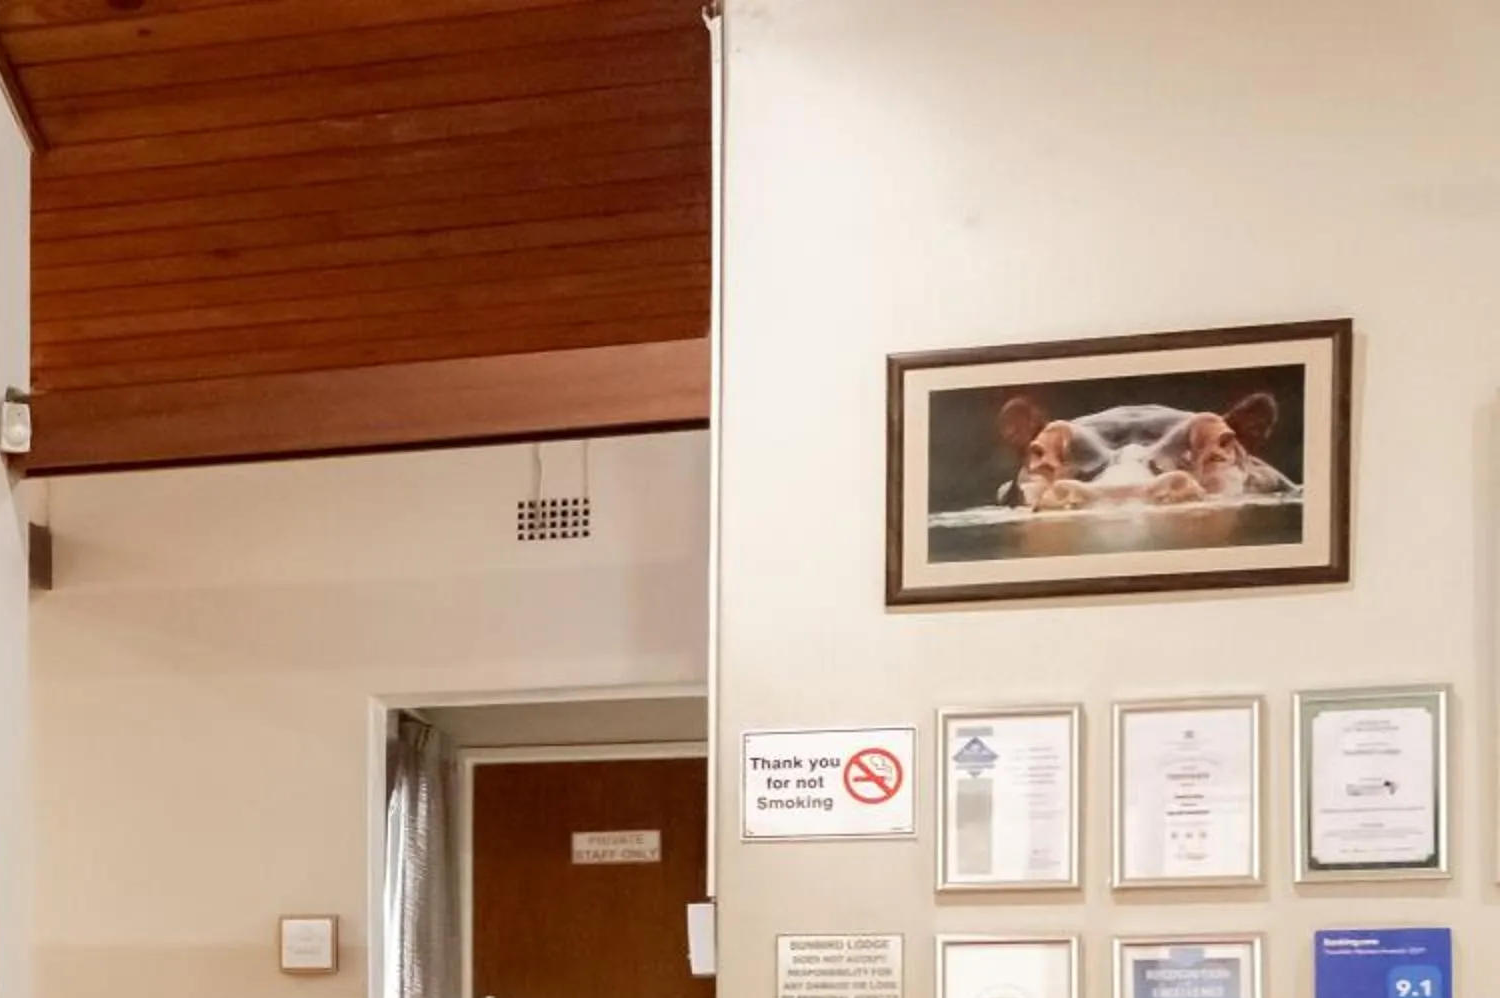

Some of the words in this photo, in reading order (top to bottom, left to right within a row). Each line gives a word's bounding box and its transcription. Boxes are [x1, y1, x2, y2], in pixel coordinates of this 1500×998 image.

[750, 756, 803, 771] Thank
[809, 757, 841, 772] you
[766, 776, 790, 790] for
[796, 776, 825, 790] not
[756, 796, 834, 812] Smoking
[587, 832, 645, 846] PRIVATE
[575, 849, 617, 859] STAFF
[847, 939, 891, 950] LODGE
[1395, 979, 1432, 997] 9.1
